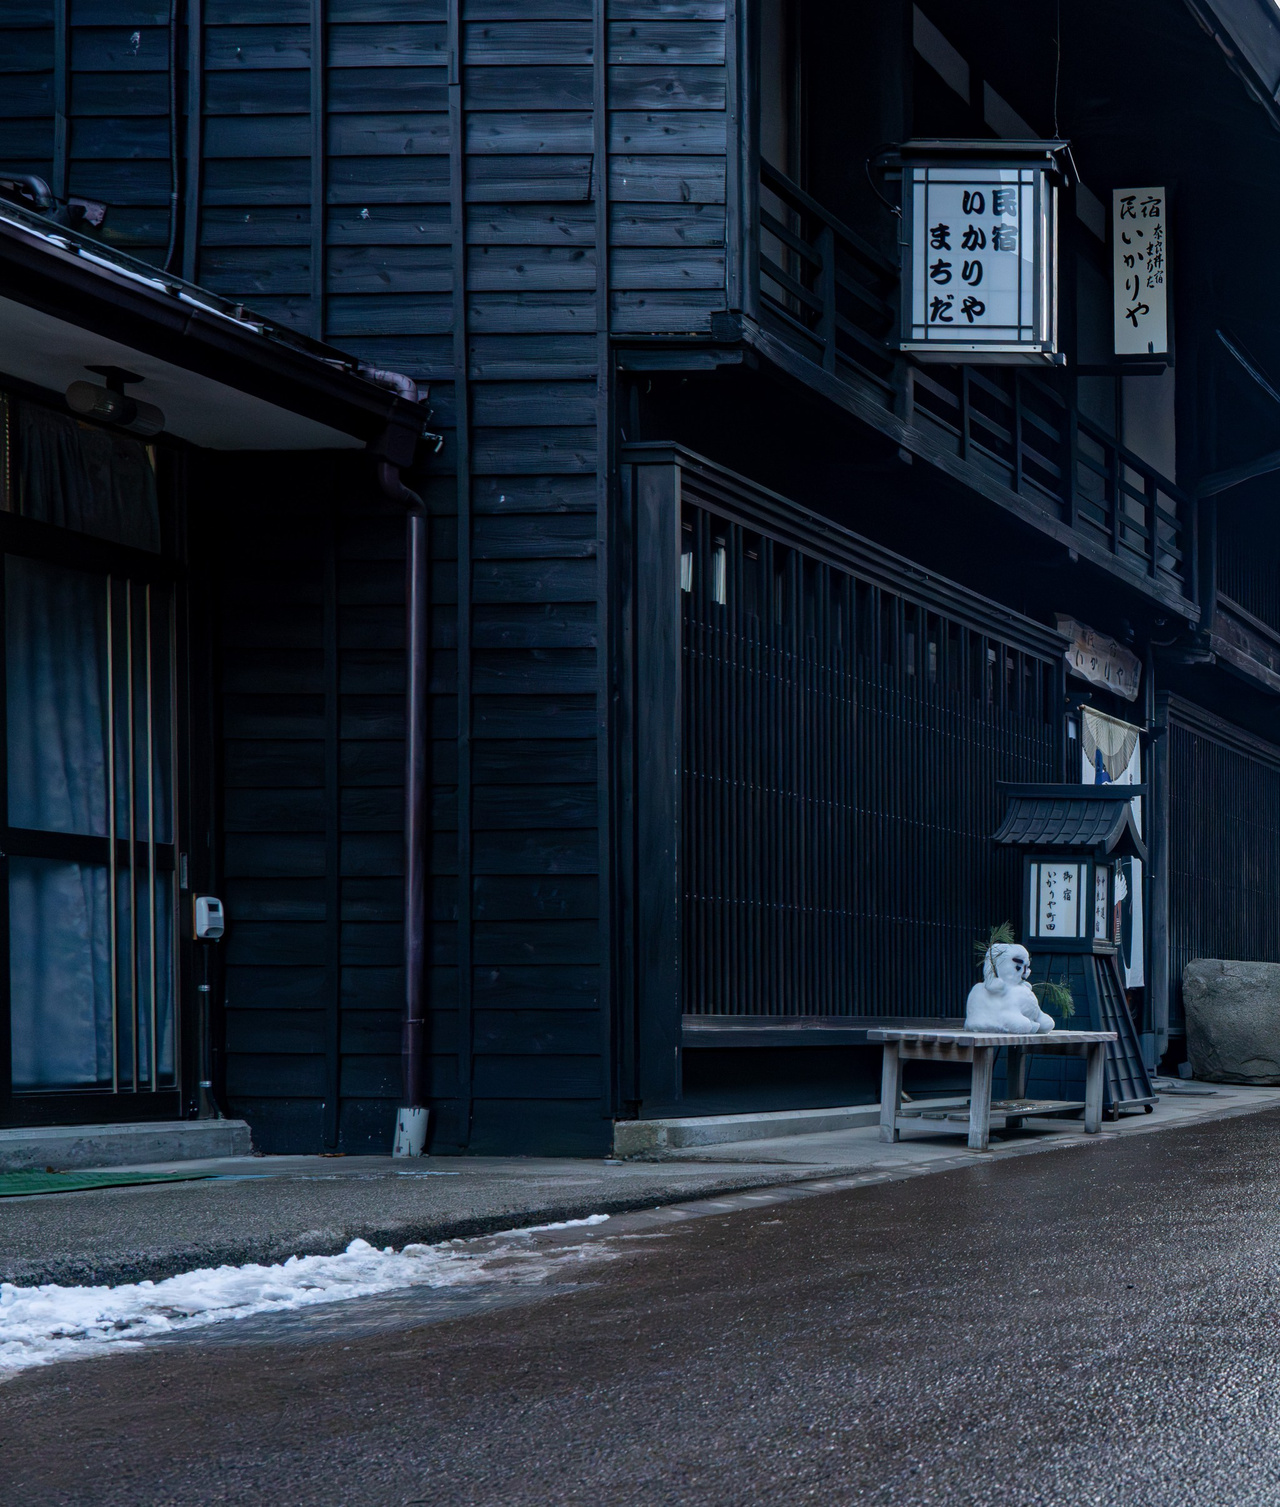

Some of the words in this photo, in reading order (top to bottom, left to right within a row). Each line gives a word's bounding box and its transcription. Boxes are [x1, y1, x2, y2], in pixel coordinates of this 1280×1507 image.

[991, 188, 1018, 252] 民宿
[929, 223, 954, 323] まちだ
[960, 190, 986, 323] いかりや
[1120, 229, 1150, 328] いかりや
[1075, 650, 1124, 686] いかりや
[1046, 871, 1057, 931] いかりや町田
[1063, 871, 1073, 901] 御宿
